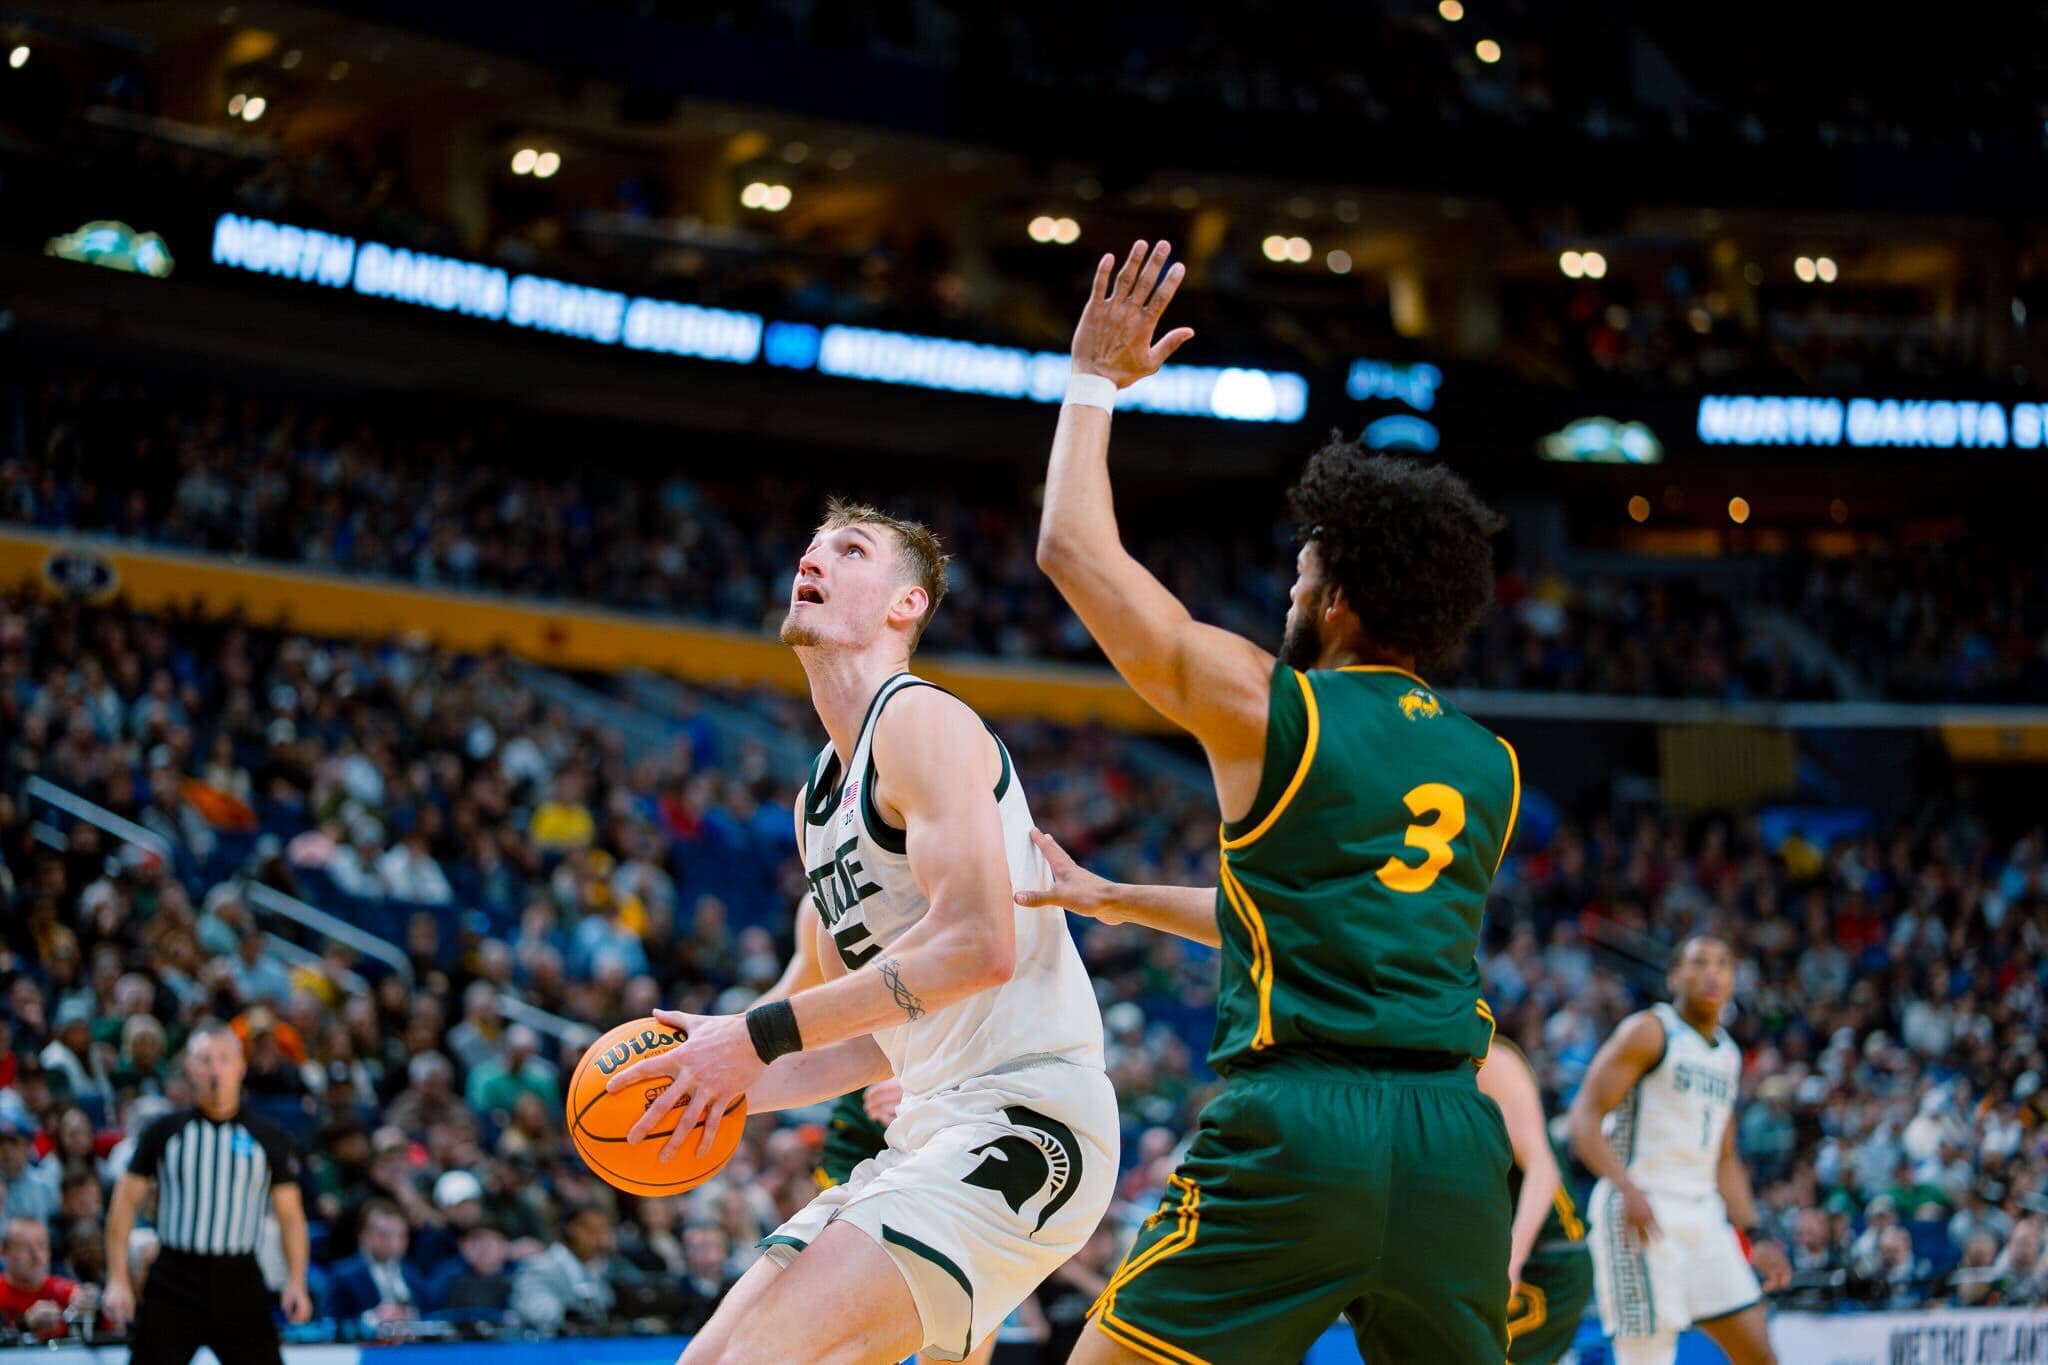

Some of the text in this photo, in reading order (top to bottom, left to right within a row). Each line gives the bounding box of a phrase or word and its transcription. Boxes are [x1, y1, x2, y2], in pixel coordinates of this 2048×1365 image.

[214, 214, 354, 286] NORTH
[355, 243, 508, 318] DAKOTA
[1699, 398, 1843, 442] NORTH
[1846, 400, 2006, 446] DAKOTA
[1376, 783, 1466, 893] 3
[594, 1030, 689, 1074] Wilso
